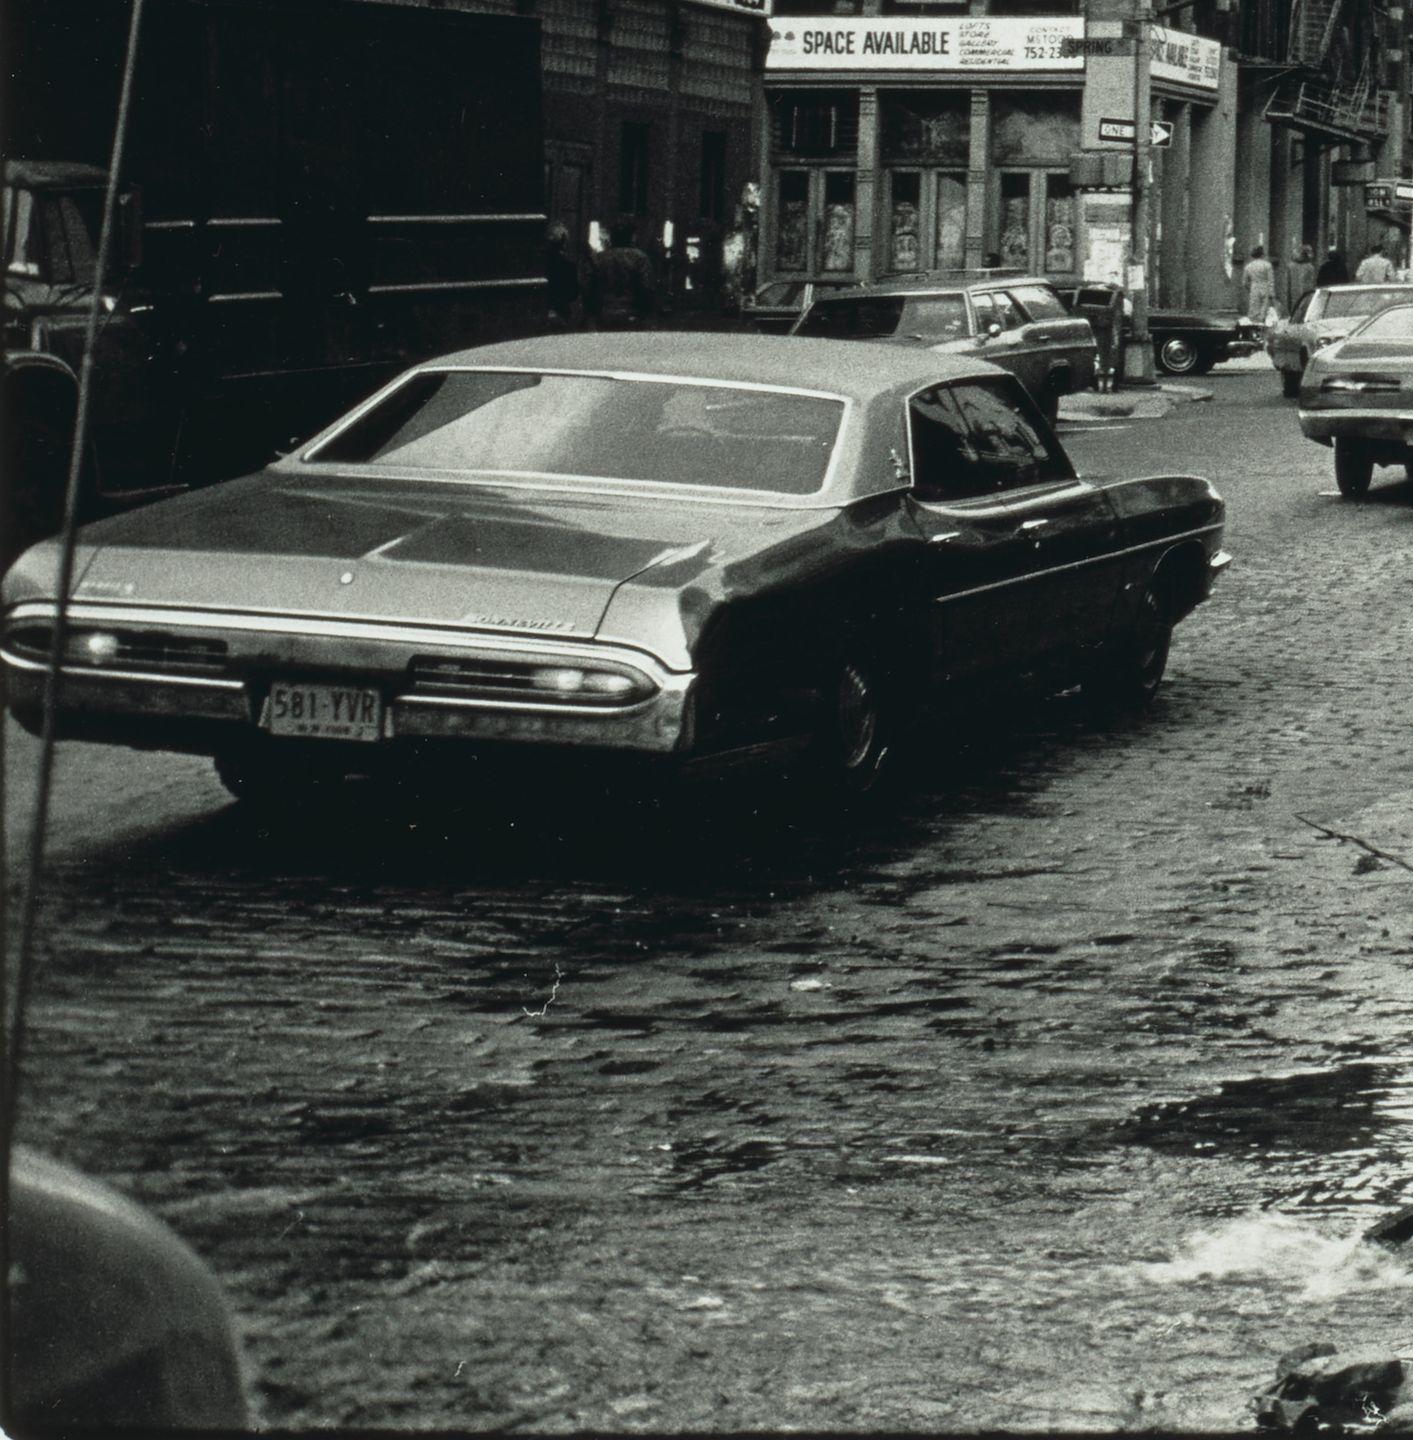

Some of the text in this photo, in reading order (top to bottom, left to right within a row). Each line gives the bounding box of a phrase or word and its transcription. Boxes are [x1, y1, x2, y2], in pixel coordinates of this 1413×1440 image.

[802, 30, 856, 55] SPACE
[862, 31, 950, 55] AVAILABLE
[1066, 40, 1113, 55] SPRING
[1023, 46, 1077, 59] 752-23
[1103, 124, 1126, 137] ONE
[274, 688, 375, 723] 581-YVR
